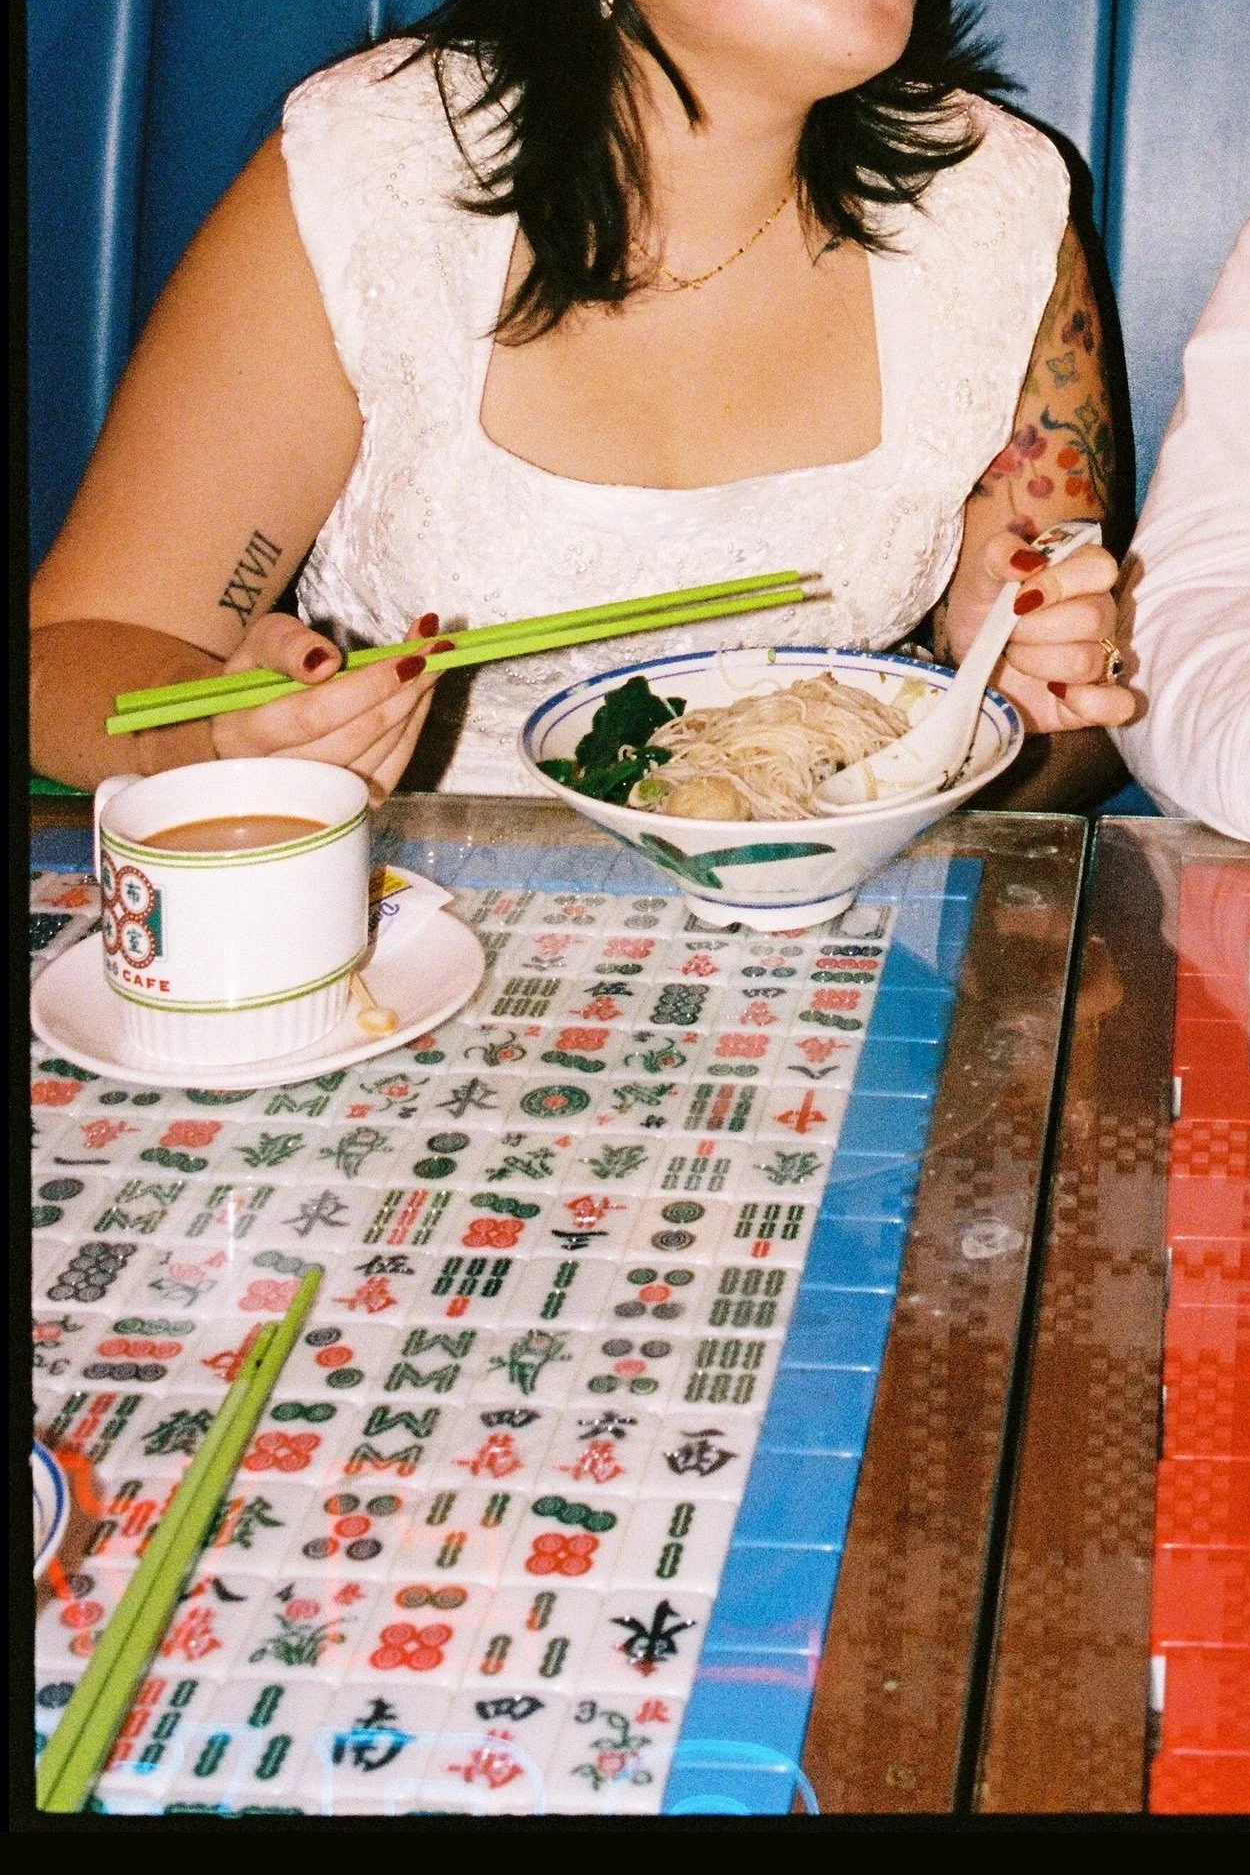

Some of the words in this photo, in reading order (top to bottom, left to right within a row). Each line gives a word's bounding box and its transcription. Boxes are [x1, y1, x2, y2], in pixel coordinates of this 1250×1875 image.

[218, 529, 283, 627] XXVII
[122, 969, 171, 993] CAFE
[774, 1090, 827, 1134] 中
[452, 1408, 542, 1479] 四萬
[448, 1694, 546, 1789] 四萬
